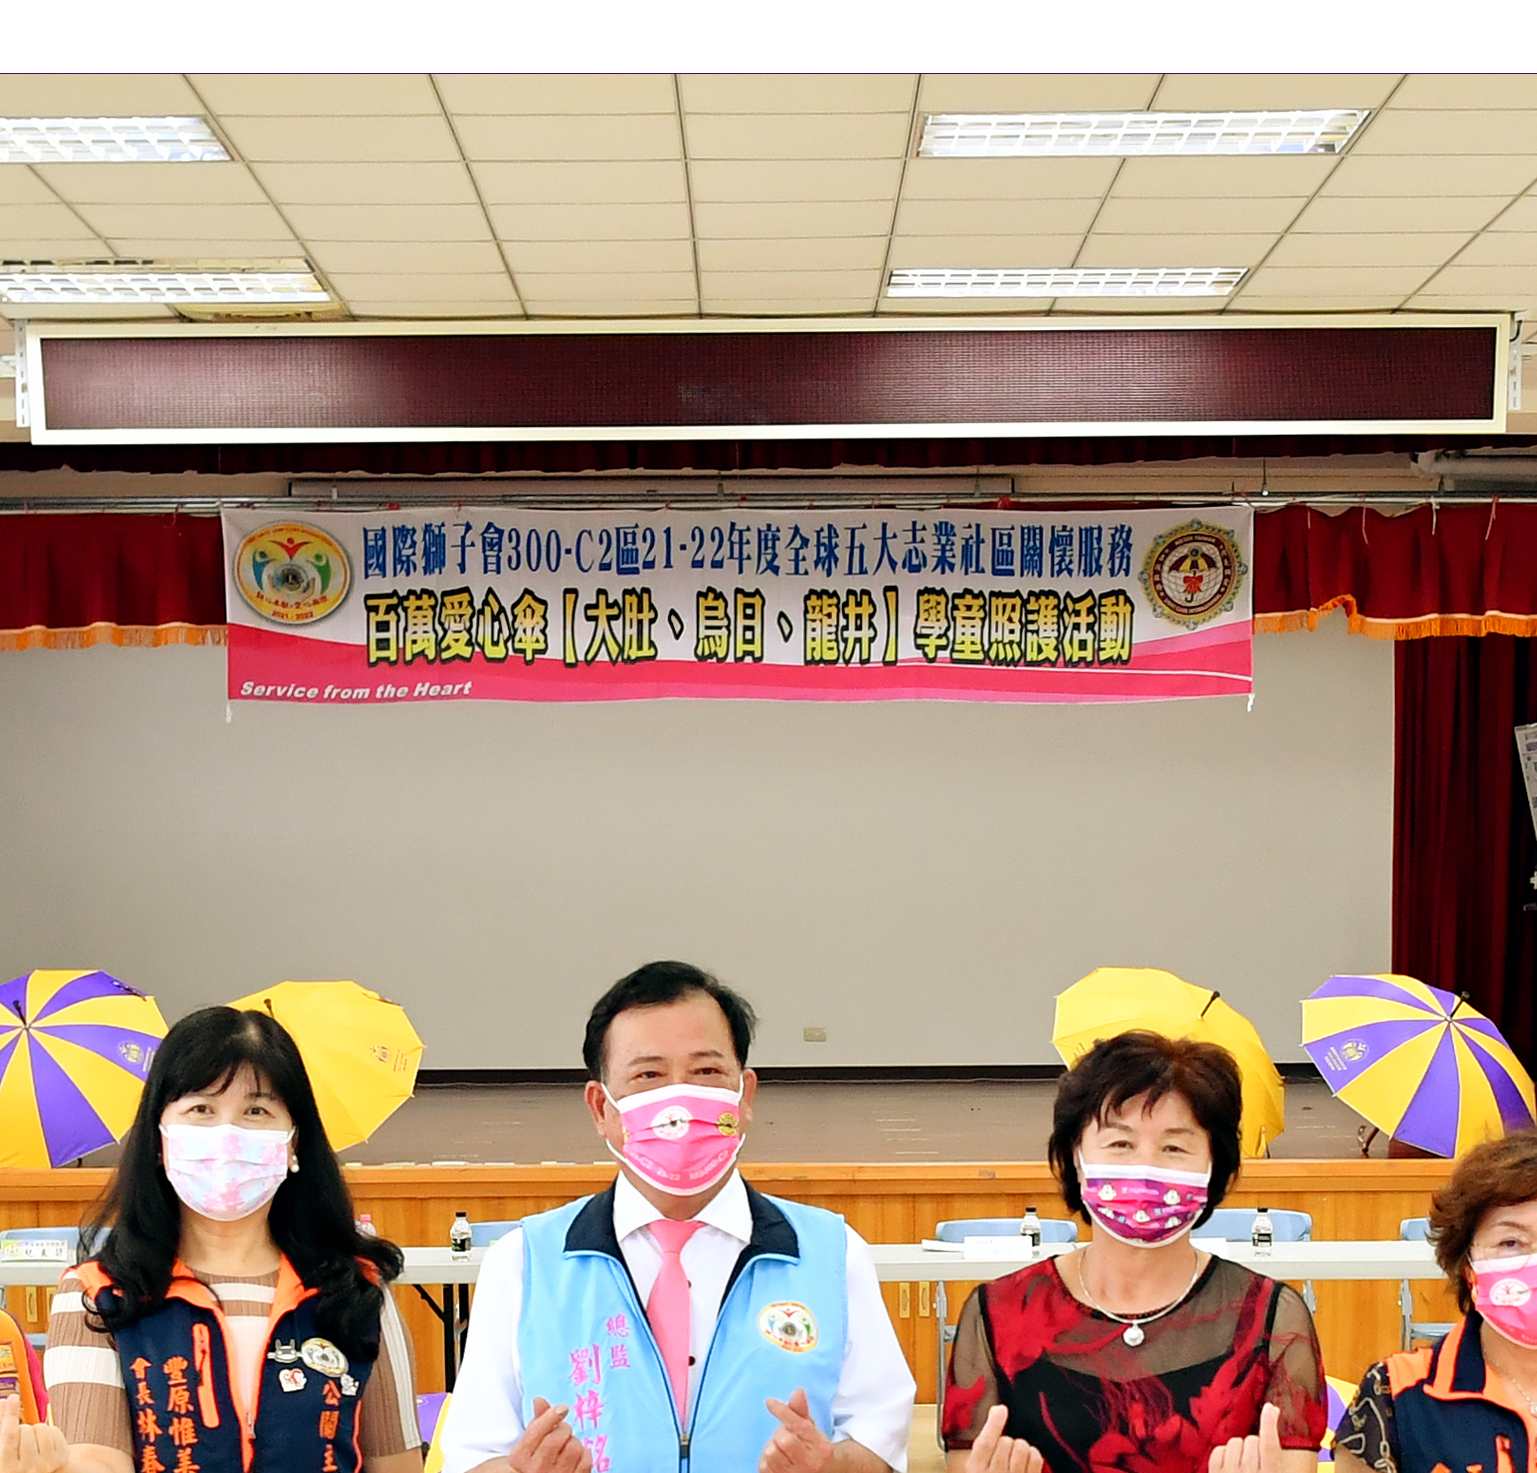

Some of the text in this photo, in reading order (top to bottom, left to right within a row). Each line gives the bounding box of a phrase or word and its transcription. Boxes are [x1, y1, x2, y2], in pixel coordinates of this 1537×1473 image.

[363, 521, 1133, 580] 國際獅子會300-C2區21-22年度全球五大志業社區關懷服務
[364, 587, 1135, 667] 百萬愛心傘【大肚、烏日、龍井】學童照護活動
[240, 681, 472, 699] Service from the Heart
[606, 1313, 631, 1369] 總監
